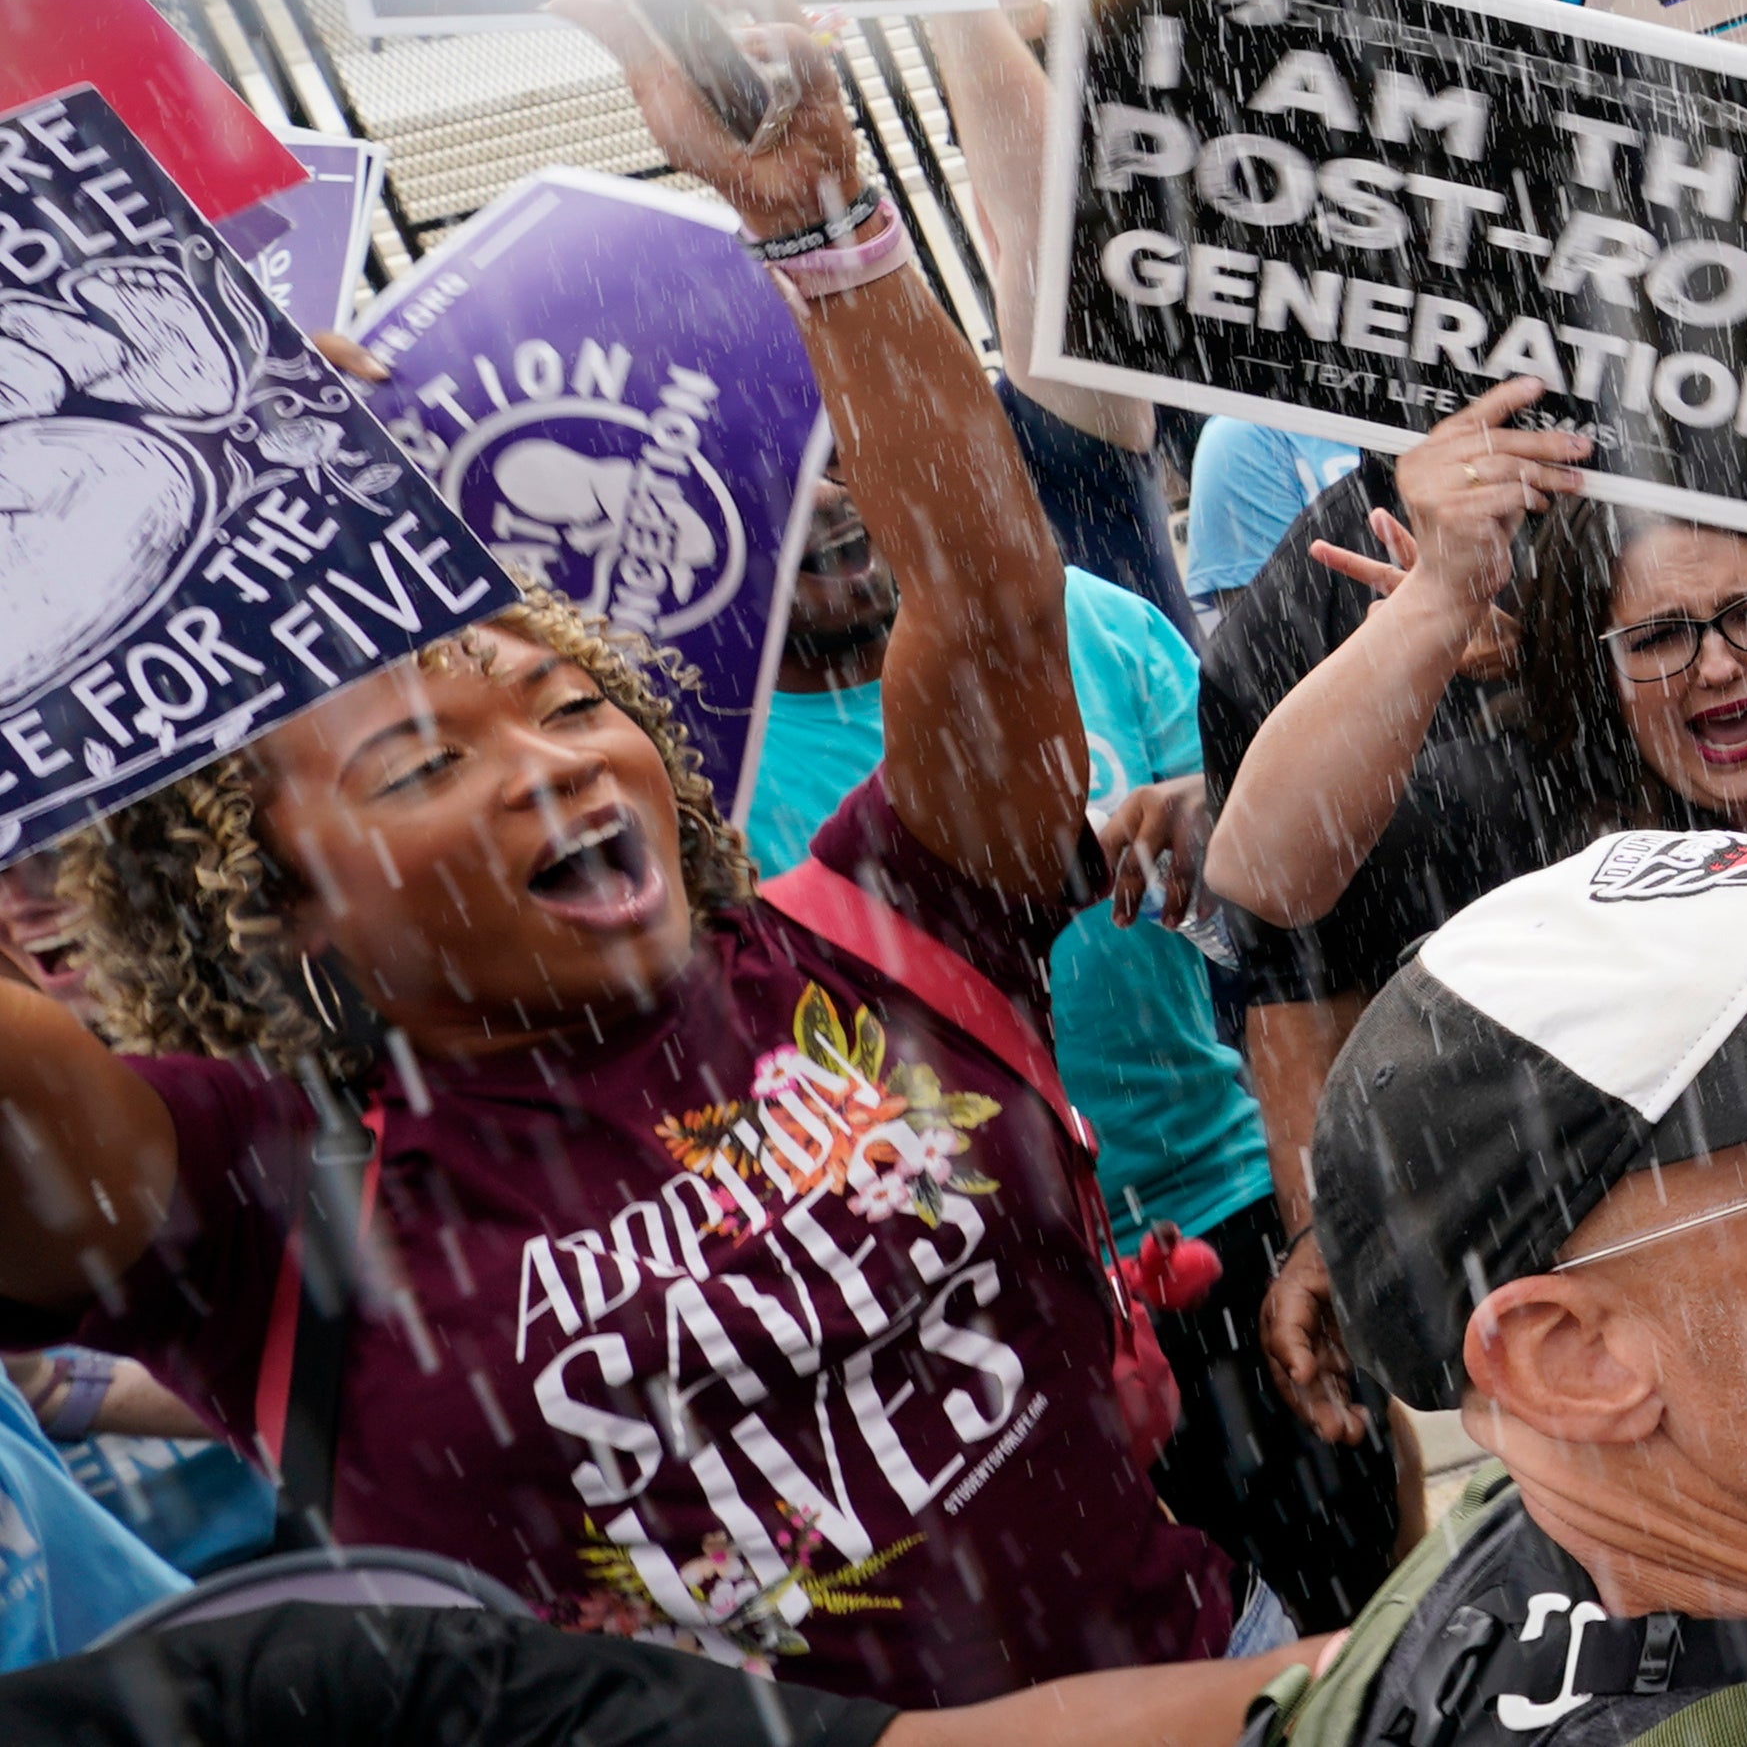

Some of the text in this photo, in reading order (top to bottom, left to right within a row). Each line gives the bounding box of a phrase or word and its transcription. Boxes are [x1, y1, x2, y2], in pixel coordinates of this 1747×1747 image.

[1140, 15, 1184, 89] I
[1247, 50, 1492, 163] AM
[1301, 358, 1380, 394] TEXT
[1388, 379, 1458, 414] LIFE
[203, 489, 342, 604] THE
[271, 511, 491, 687] FIVE
[73, 605, 266, 748] FOR
[516, 1031, 881, 1364] ADOPTION
[534, 1118, 987, 1506] SAVES
[606, 1260, 1025, 1681] LIVES
[943, 1391, 1050, 1517] STUDENTSFORLIFE.ORG
